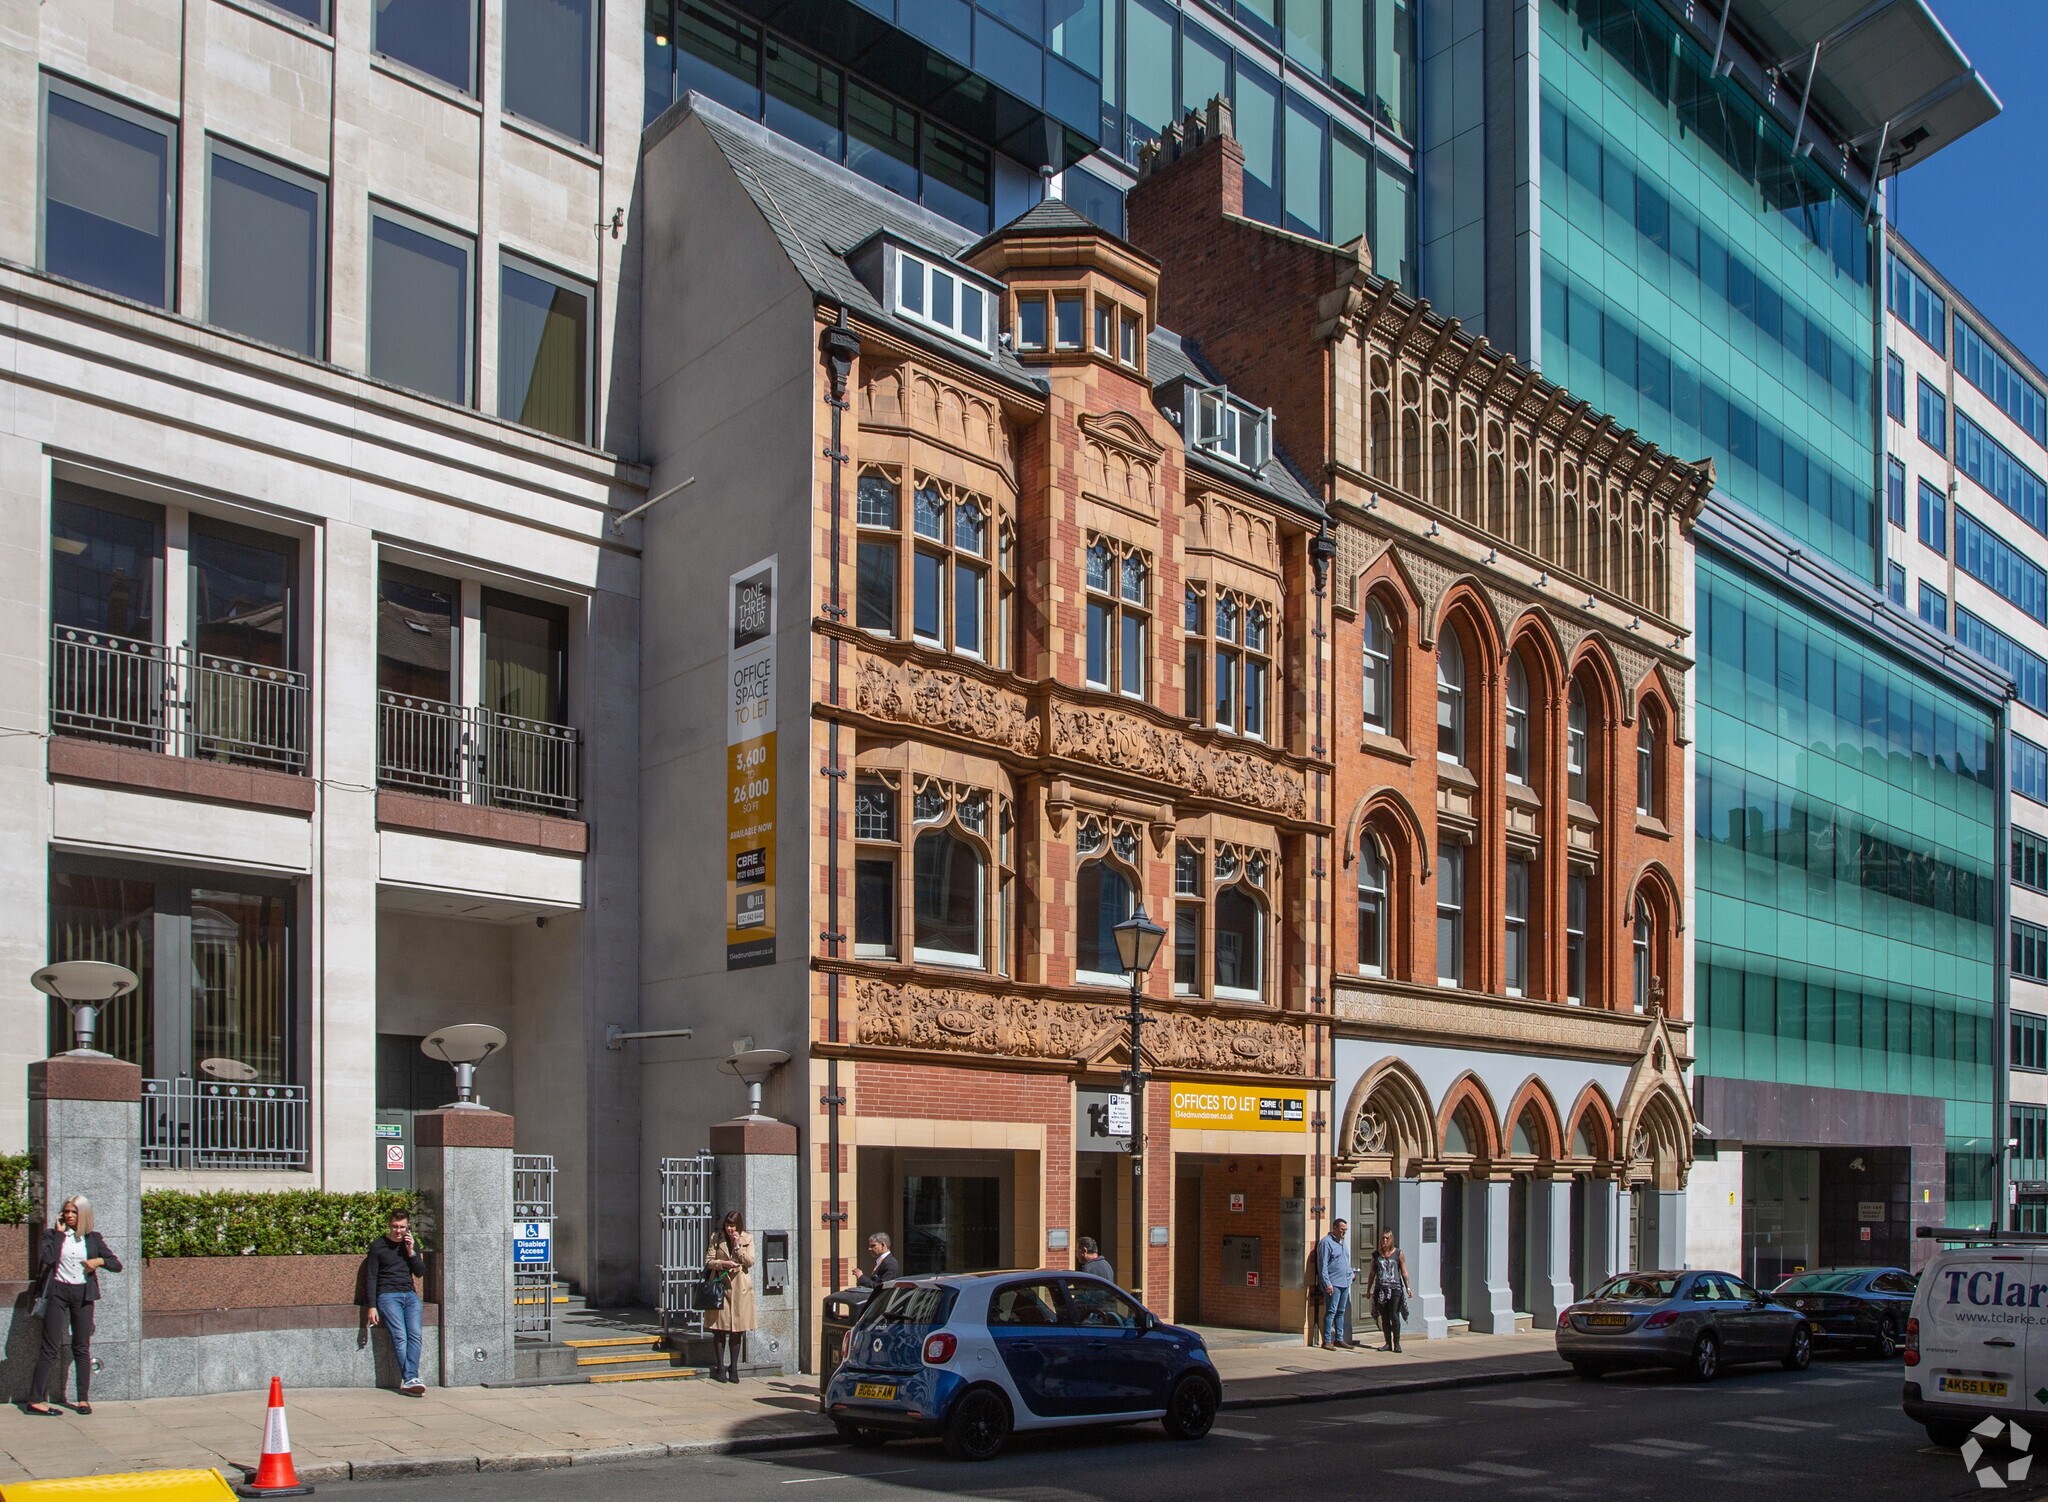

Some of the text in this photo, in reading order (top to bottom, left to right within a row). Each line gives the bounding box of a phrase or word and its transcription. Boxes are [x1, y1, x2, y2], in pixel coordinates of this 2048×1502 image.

[743, 582, 763, 603] ONE
[739, 595, 766, 619] THREE
[739, 610, 765, 634] FOUR
[734, 658, 771, 687] OFFICE
[735, 678, 769, 706] SPACE
[735, 699, 769, 726] TO LET
[736, 746, 766, 771] 3,600
[747, 769, 755, 779] TO
[733, 777, 769, 804] 26,000
[743, 801, 759, 813] SQ FT
[730, 821, 773, 840] AVAILABLE NOW
[736, 853, 758, 868] CBRE
[736, 870, 747, 880] 0121
[754, 895, 764, 906] JLL
[729, 947, 774, 960] 134edmundstreet.co.uk
[1173, 1093, 1256, 1112] OFFICES TO LET
[1260, 1100, 1277, 1109] CBRE
[1175, 1110, 1234, 1120] 134edmundstreet.co.uk
[1945, 1271, 2048, 1308] TClar
[1955, 1312, 2048, 1326] www.tclarke.c
[1946, 1378, 2005, 1394] AK65 LWP
